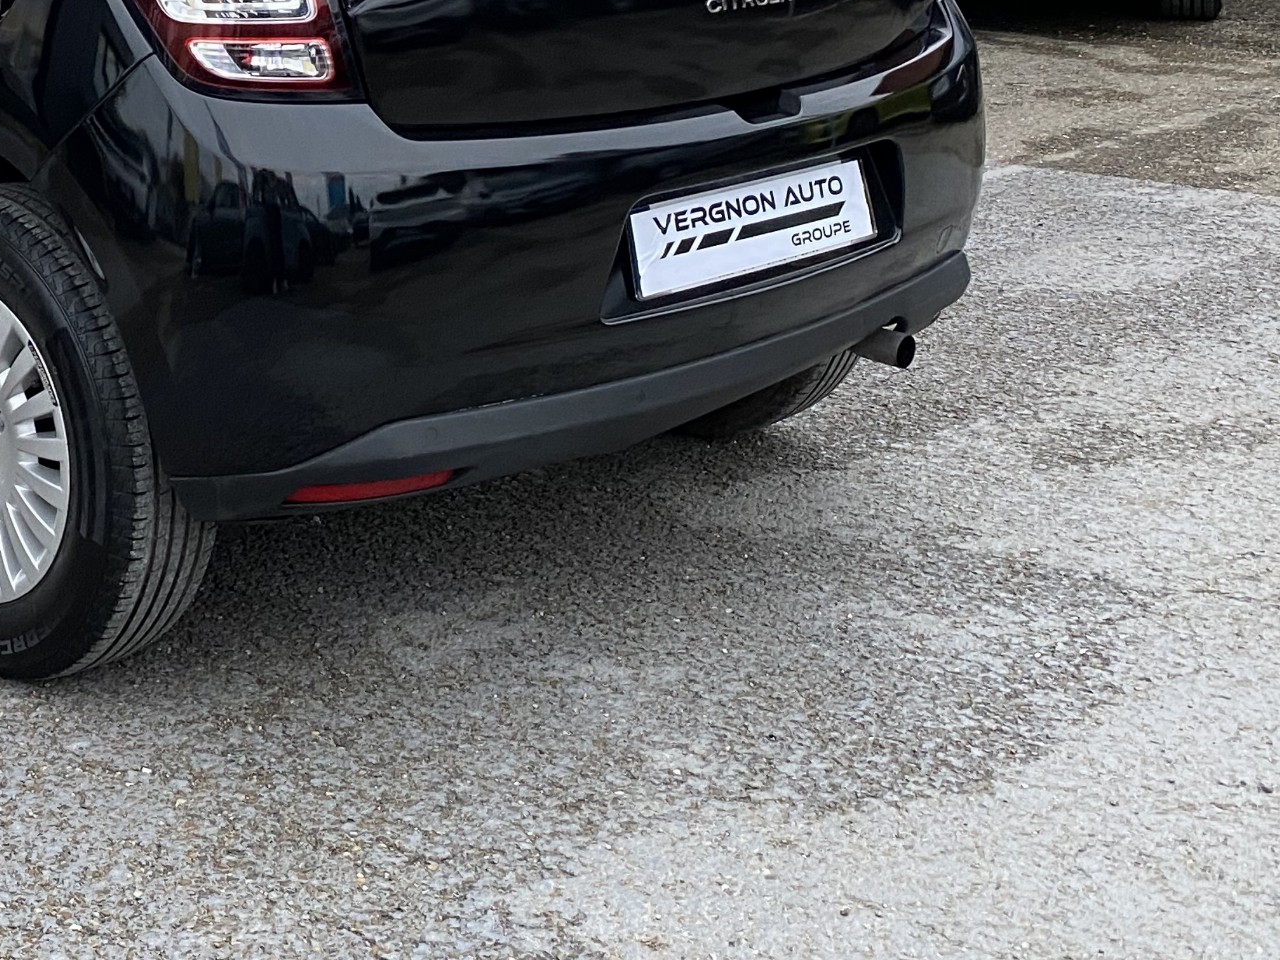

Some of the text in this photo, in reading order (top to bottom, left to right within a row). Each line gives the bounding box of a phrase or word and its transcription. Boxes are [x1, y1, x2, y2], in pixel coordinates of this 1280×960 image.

[654, 175, 843, 236] VERGNON AUTO
[792, 220, 851, 246] GROUPE
